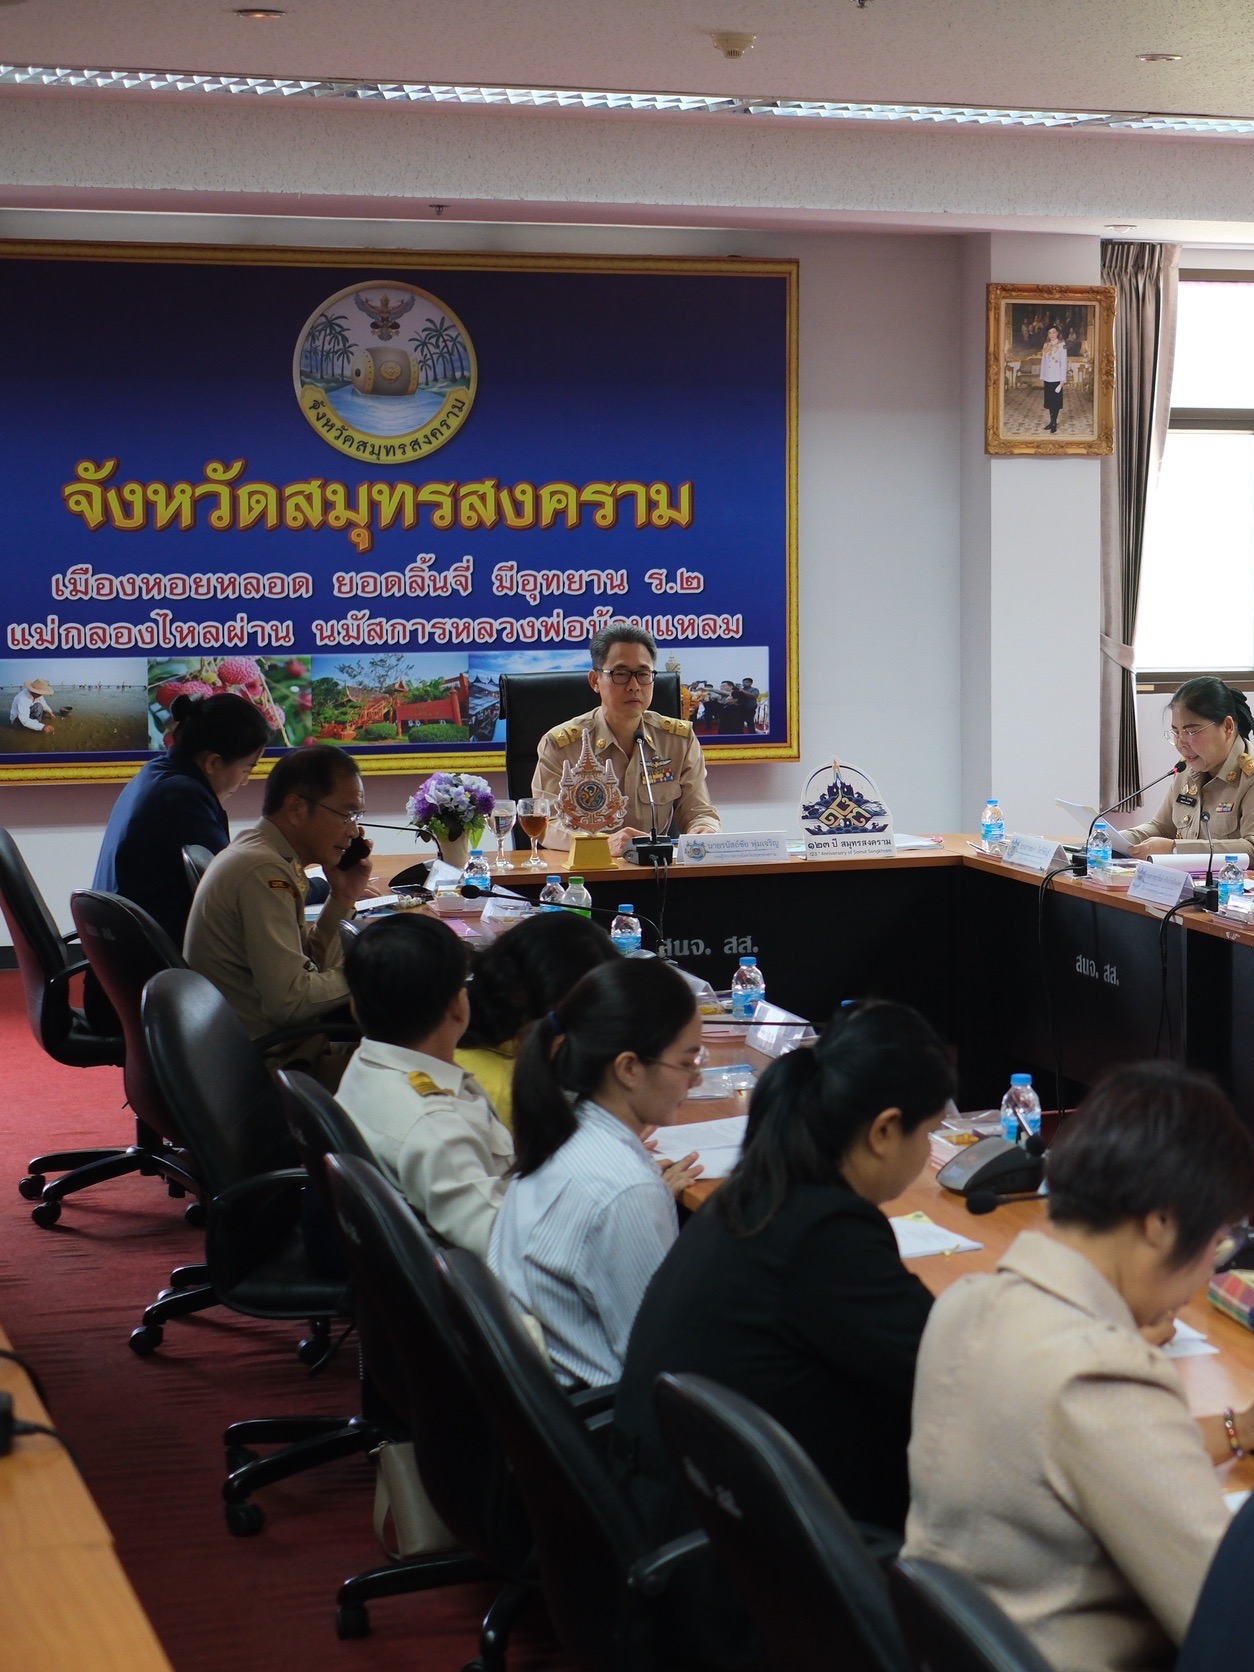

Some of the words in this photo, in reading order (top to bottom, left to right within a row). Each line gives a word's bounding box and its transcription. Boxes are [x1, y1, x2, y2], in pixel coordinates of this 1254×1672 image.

[62, 458, 694, 552] จังหวัดสมุทรสงคราม
[52, 564, 313, 600] เมืองหอยหลอด
[333, 553, 473, 598] ยอดลิ้นจี่
[492, 561, 628, 605] มีอุทยาน
[645, 568, 704, 595] ร.๒
[7, 609, 294, 650] แม่กลองไหลผ่าน
[807, 842, 830, 850] ๑๒๓
[831, 838, 838, 848] ปี
[840, 838, 892, 849] สมุทรสงคราม
[723, 935, 759, 954] สส.
[1103, 964, 1119, 986] สส.
